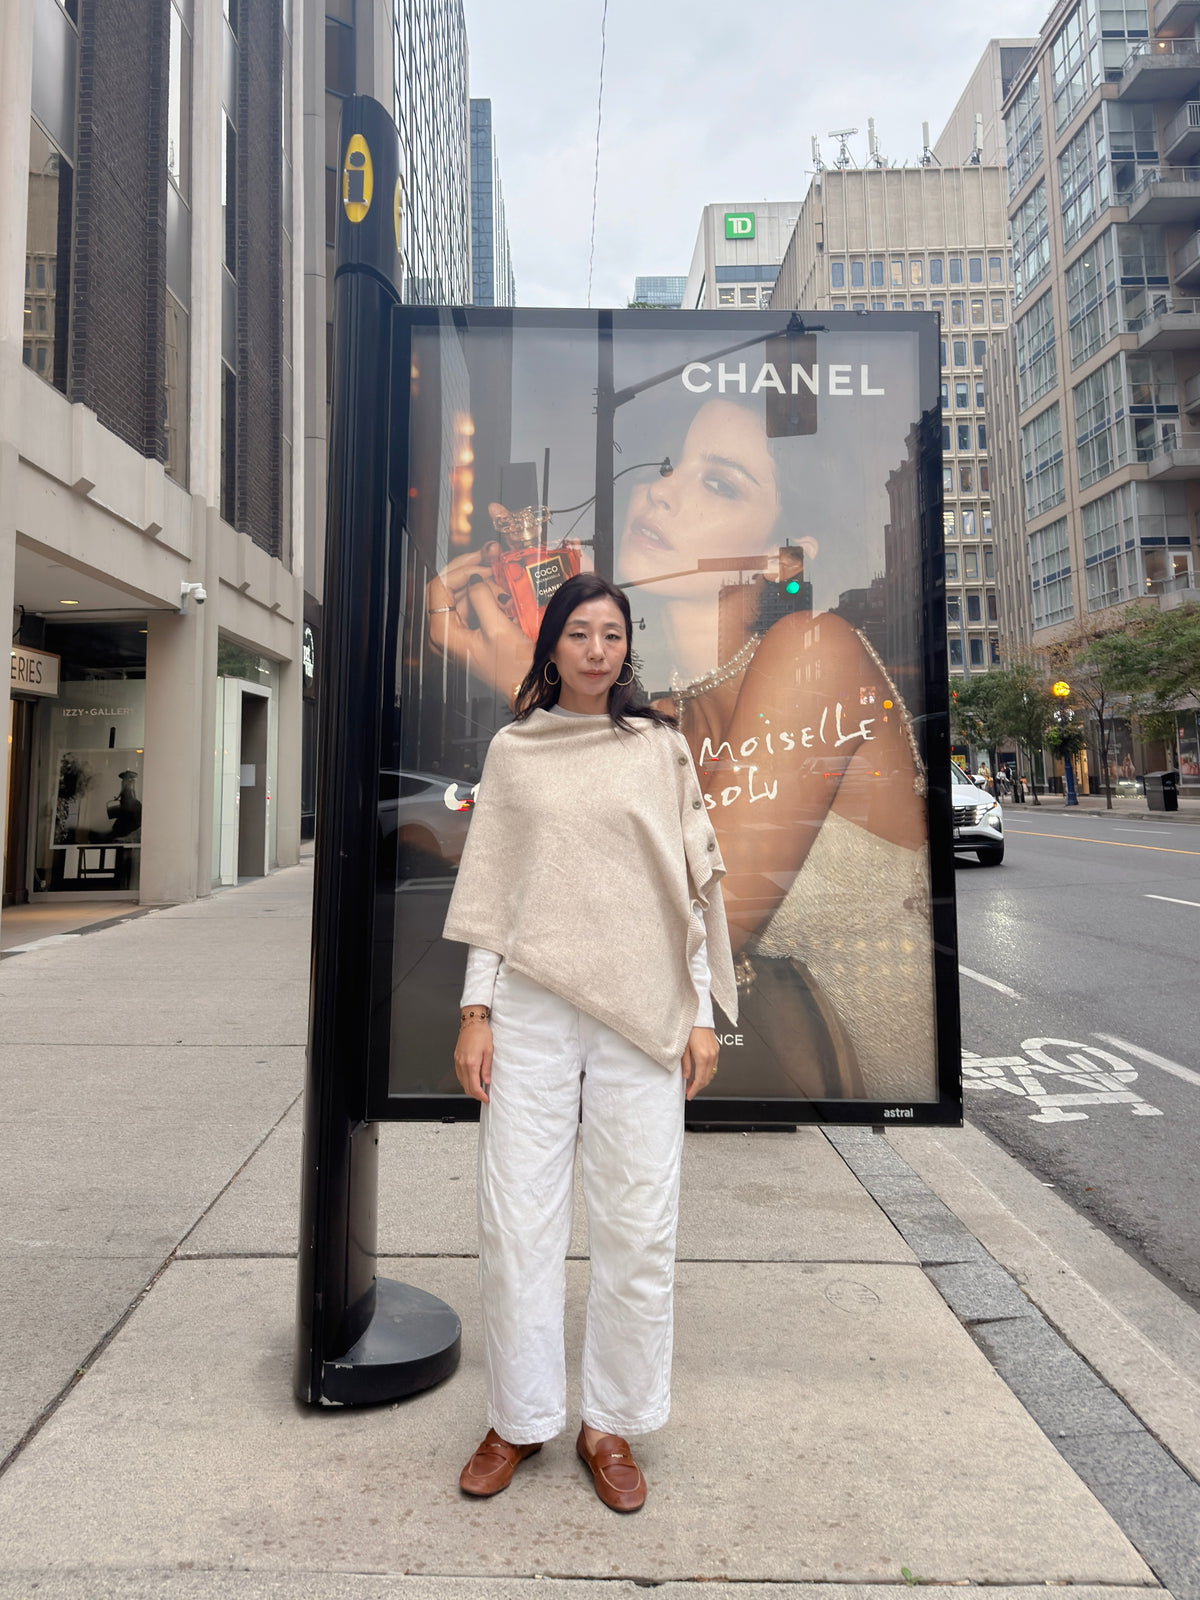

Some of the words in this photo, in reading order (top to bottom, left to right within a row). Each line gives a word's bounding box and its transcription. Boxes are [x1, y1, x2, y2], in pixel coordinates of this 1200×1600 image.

[728, 217, 752, 234] TD
[681, 362, 885, 395] CHANEL
[535, 565, 558, 579] COCO
[11, 655, 42, 685] ERIES
[883, 1107, 914, 1118] astral
